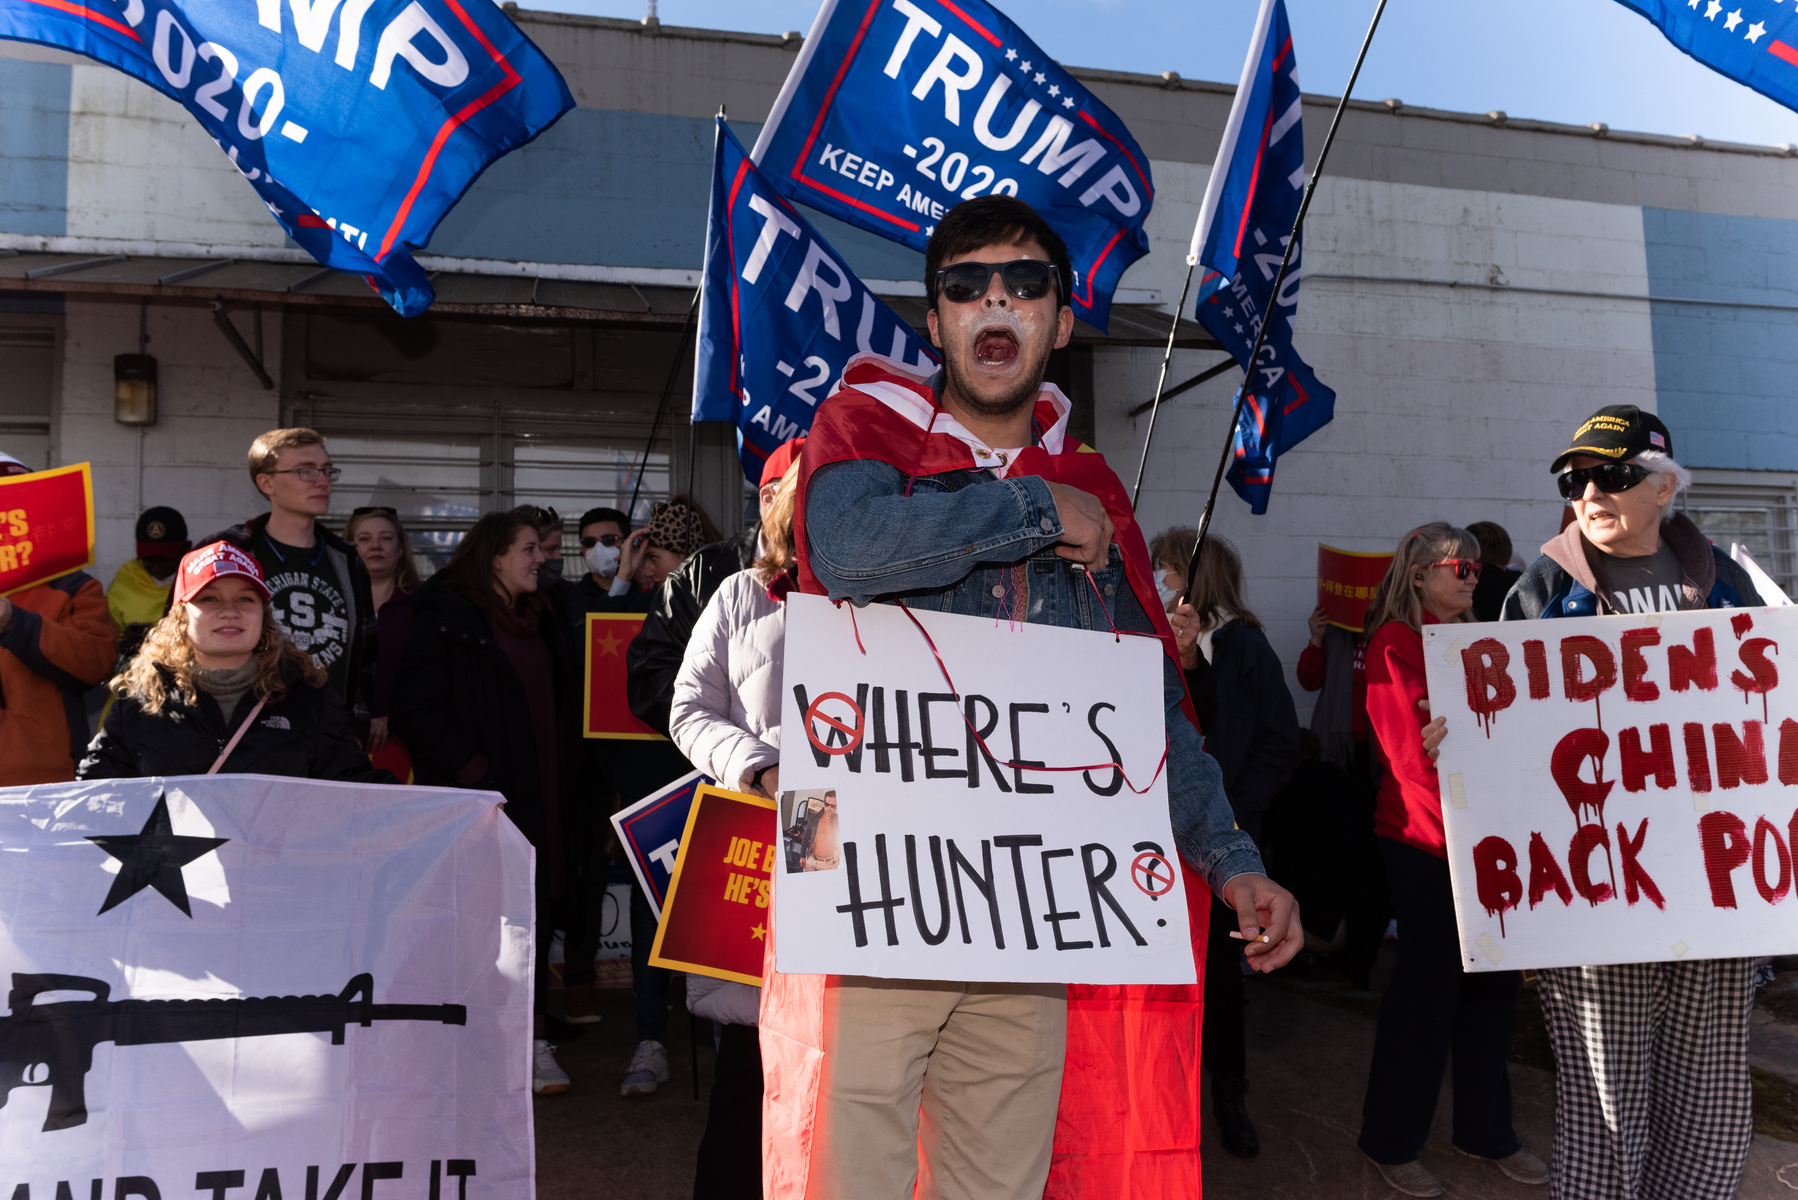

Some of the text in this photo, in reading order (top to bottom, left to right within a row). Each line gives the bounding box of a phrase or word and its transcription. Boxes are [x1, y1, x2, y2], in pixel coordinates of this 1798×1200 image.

[883, 0, 1142, 218] TRUMP
[818, 143, 949, 221] KEEP AME
[741, 193, 935, 367] TRU
[1229, 271, 1285, 389] MERCA
[776, 355, 840, 407] -2
[1594, 422, 1625, 433] AGAIN
[0, 508, 30, 537] 'S
[186, 543, 257, 573] MAKE AMERICA
[193, 552, 226, 575] GREAT
[264, 571, 345, 610] CHIGAN STATE
[289, 591, 316, 628] S
[1461, 613, 1779, 725] BIDEN'S
[792, 683, 1126, 797] WHERE'S
[723, 836, 763, 870] JOE
[1473, 806, 1798, 922] BACK PO
[723, 872, 770, 908] HE'S
[835, 833, 1168, 950] HUNTER?
